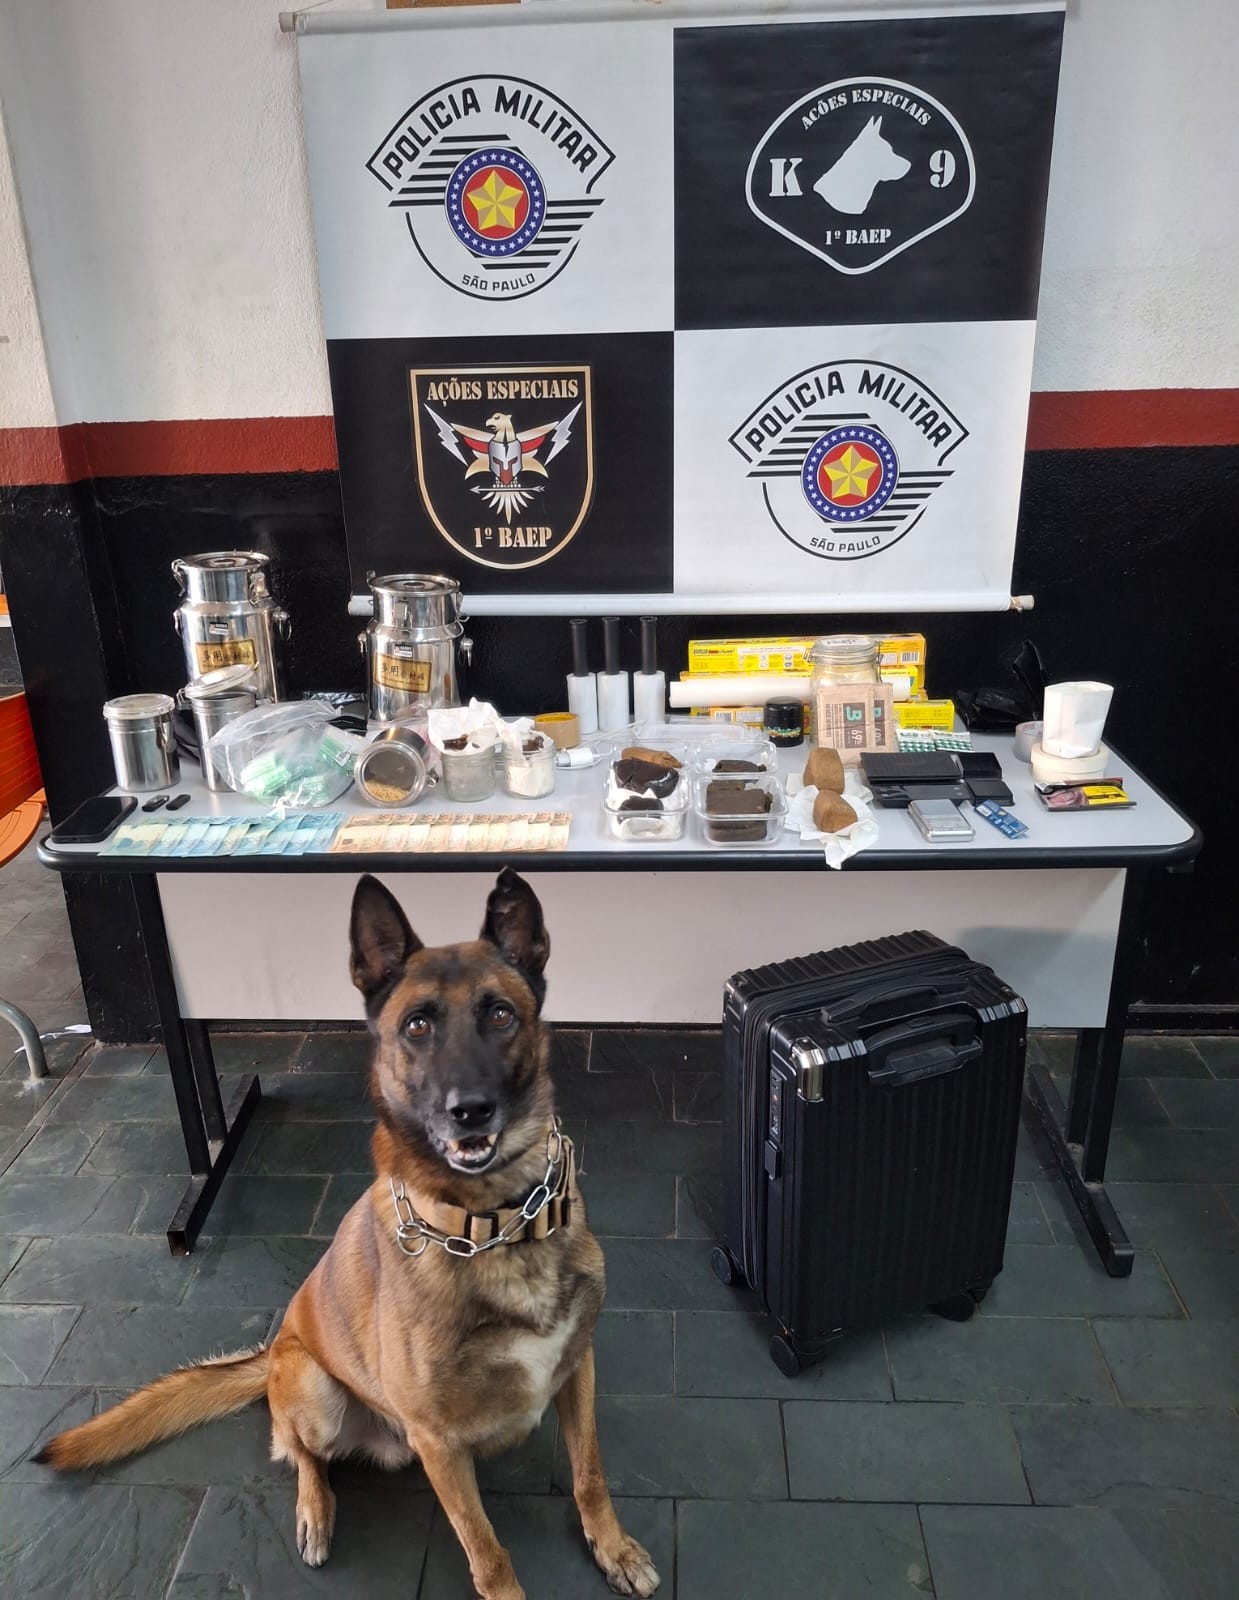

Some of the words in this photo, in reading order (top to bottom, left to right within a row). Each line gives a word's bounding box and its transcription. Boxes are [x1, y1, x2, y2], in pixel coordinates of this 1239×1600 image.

[852, 89, 931, 126] ESPECIAIS
[382, 87, 481, 179] POLICIA
[494, 85, 598, 173] MILITAR
[769, 157, 803, 197] K
[929, 150, 956, 188] 9
[845, 228, 891, 245] BAEP
[462, 274, 488, 291] SÃO
[492, 273, 535, 292] PAULO
[427, 377, 482, 407] AÇÕES
[487, 379, 579, 400] ESPECIAIS
[745, 370, 845, 453] POLICIA
[858, 369, 952, 448] MILITAR
[498, 527, 553, 548] BAEP
[809, 536, 835, 552] SÃO
[838, 535, 881, 552] PAULO
